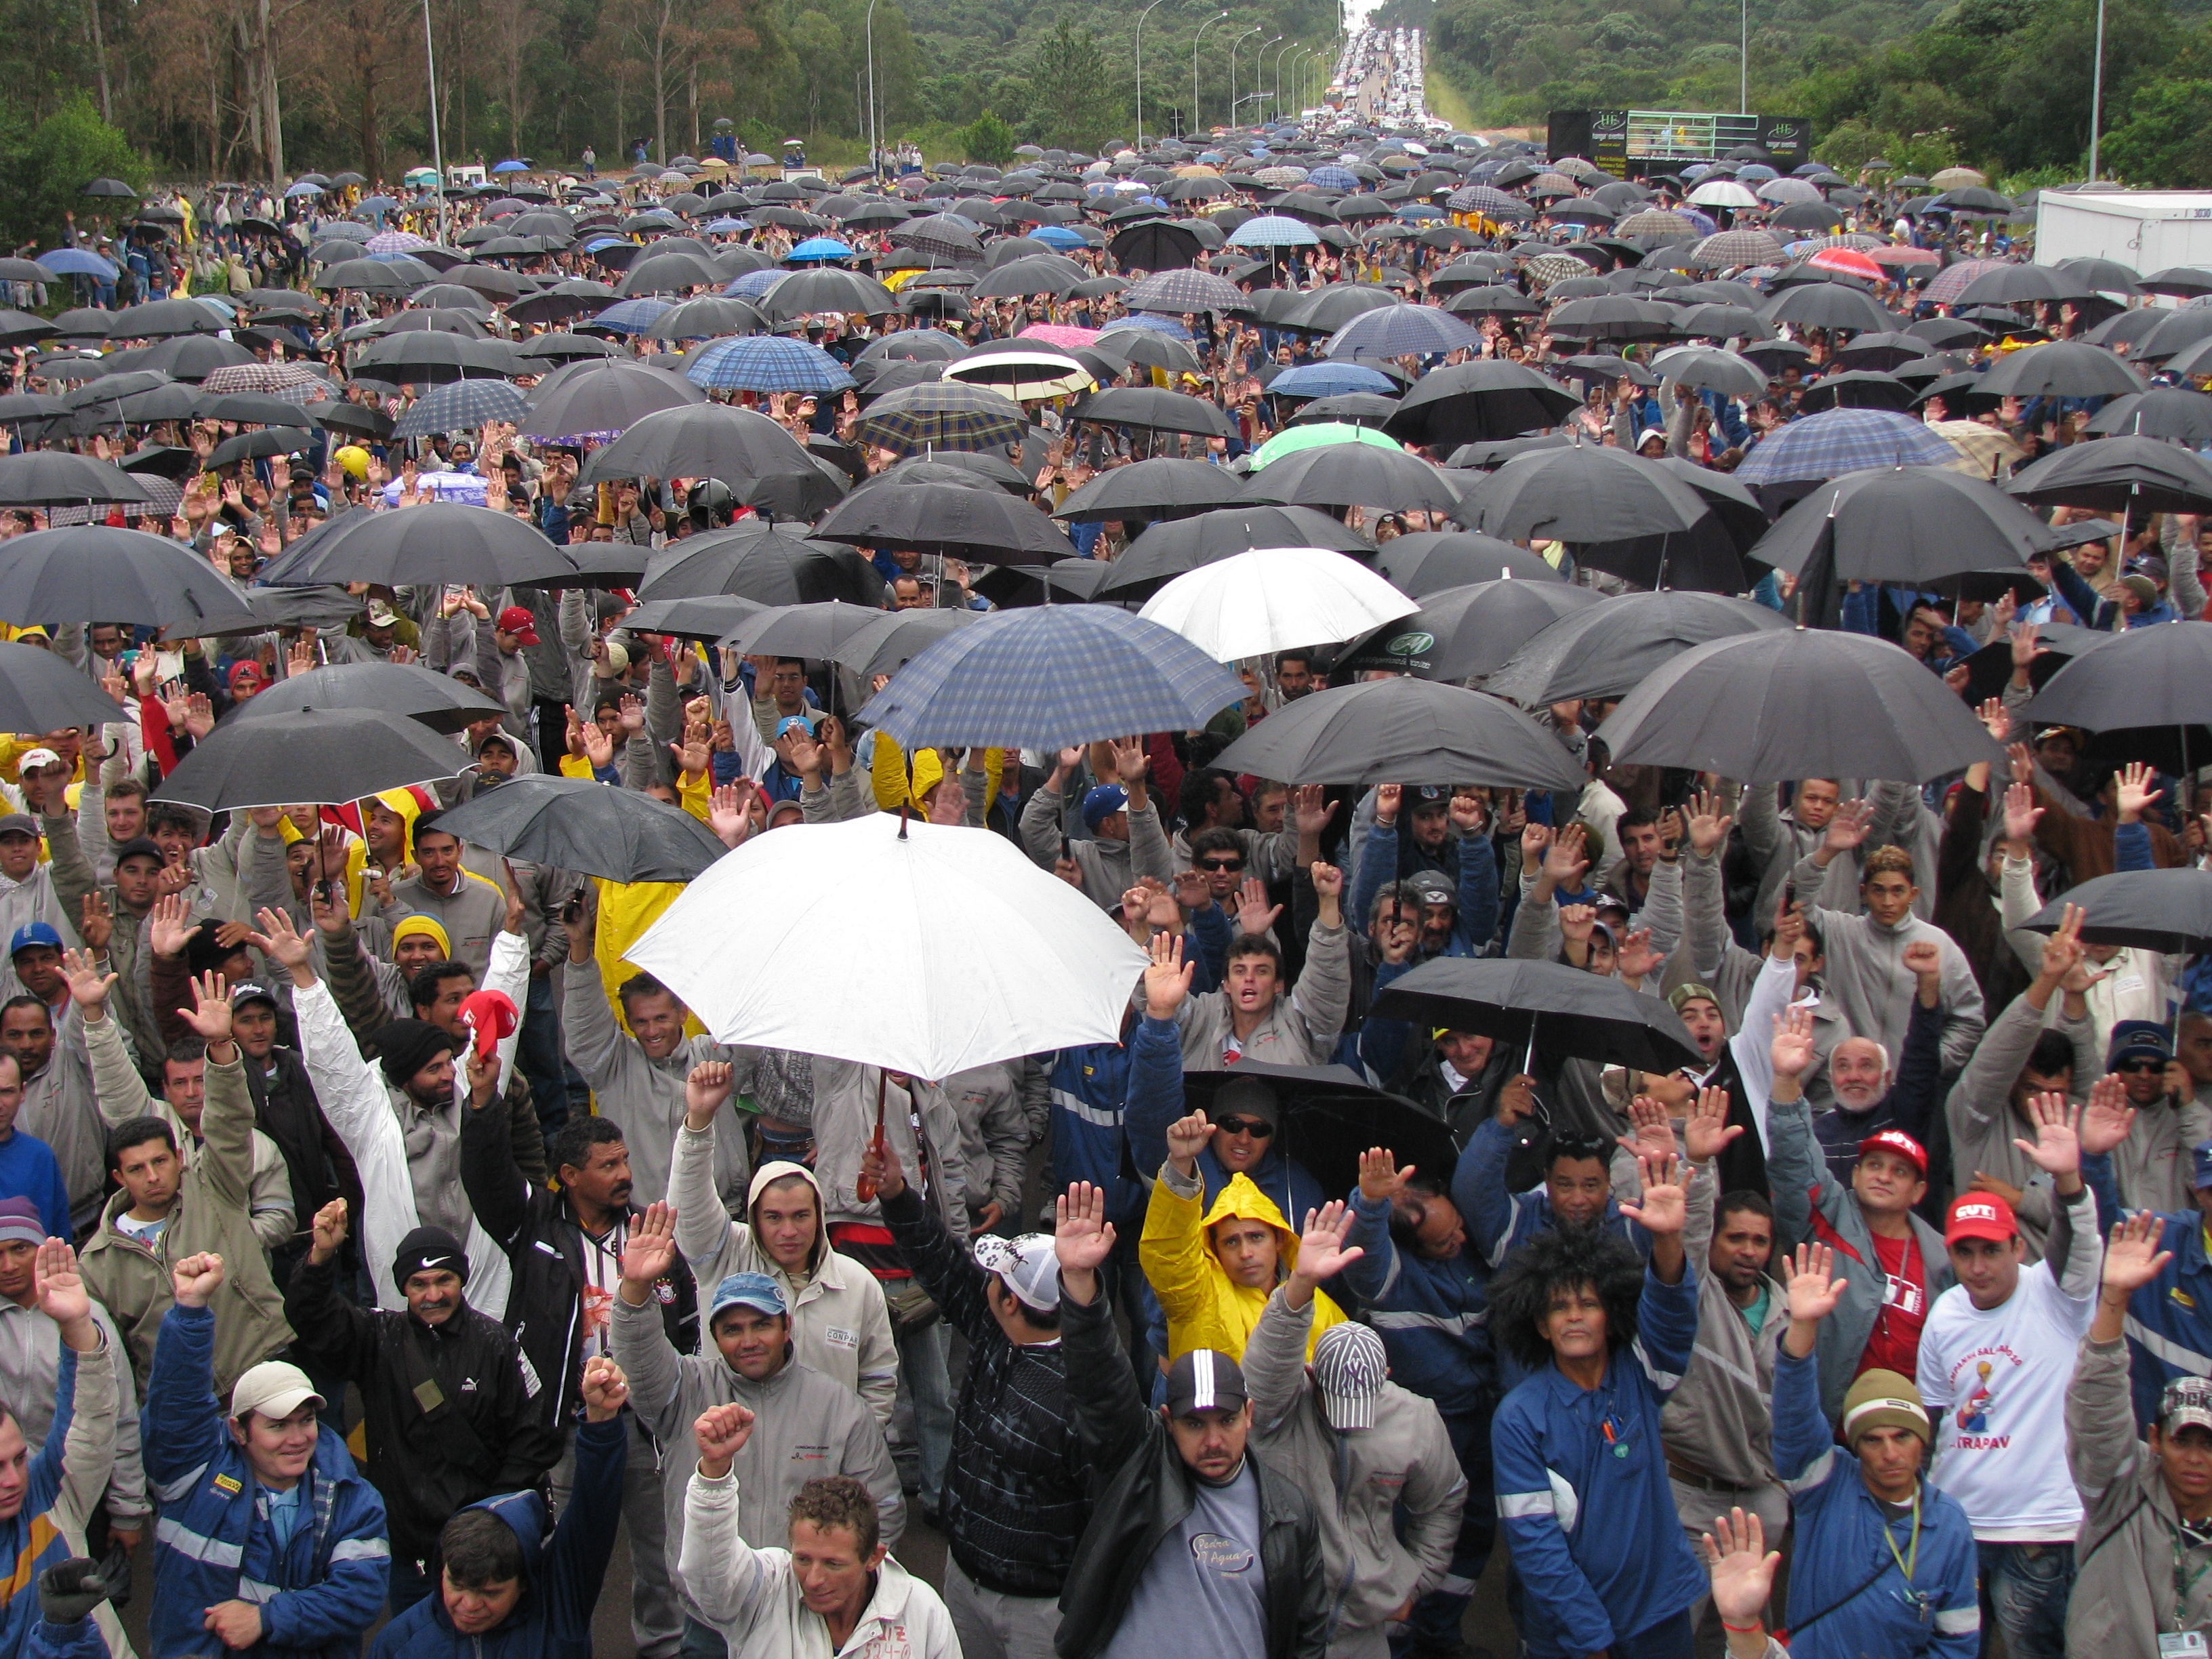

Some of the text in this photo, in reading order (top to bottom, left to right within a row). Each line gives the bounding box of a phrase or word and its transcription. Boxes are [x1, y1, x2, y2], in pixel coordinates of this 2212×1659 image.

[1955, 1204, 1993, 1218] CUT
[827, 1331, 859, 1343] CONPAR
[1199, 1538, 1229, 1549] Pedra
